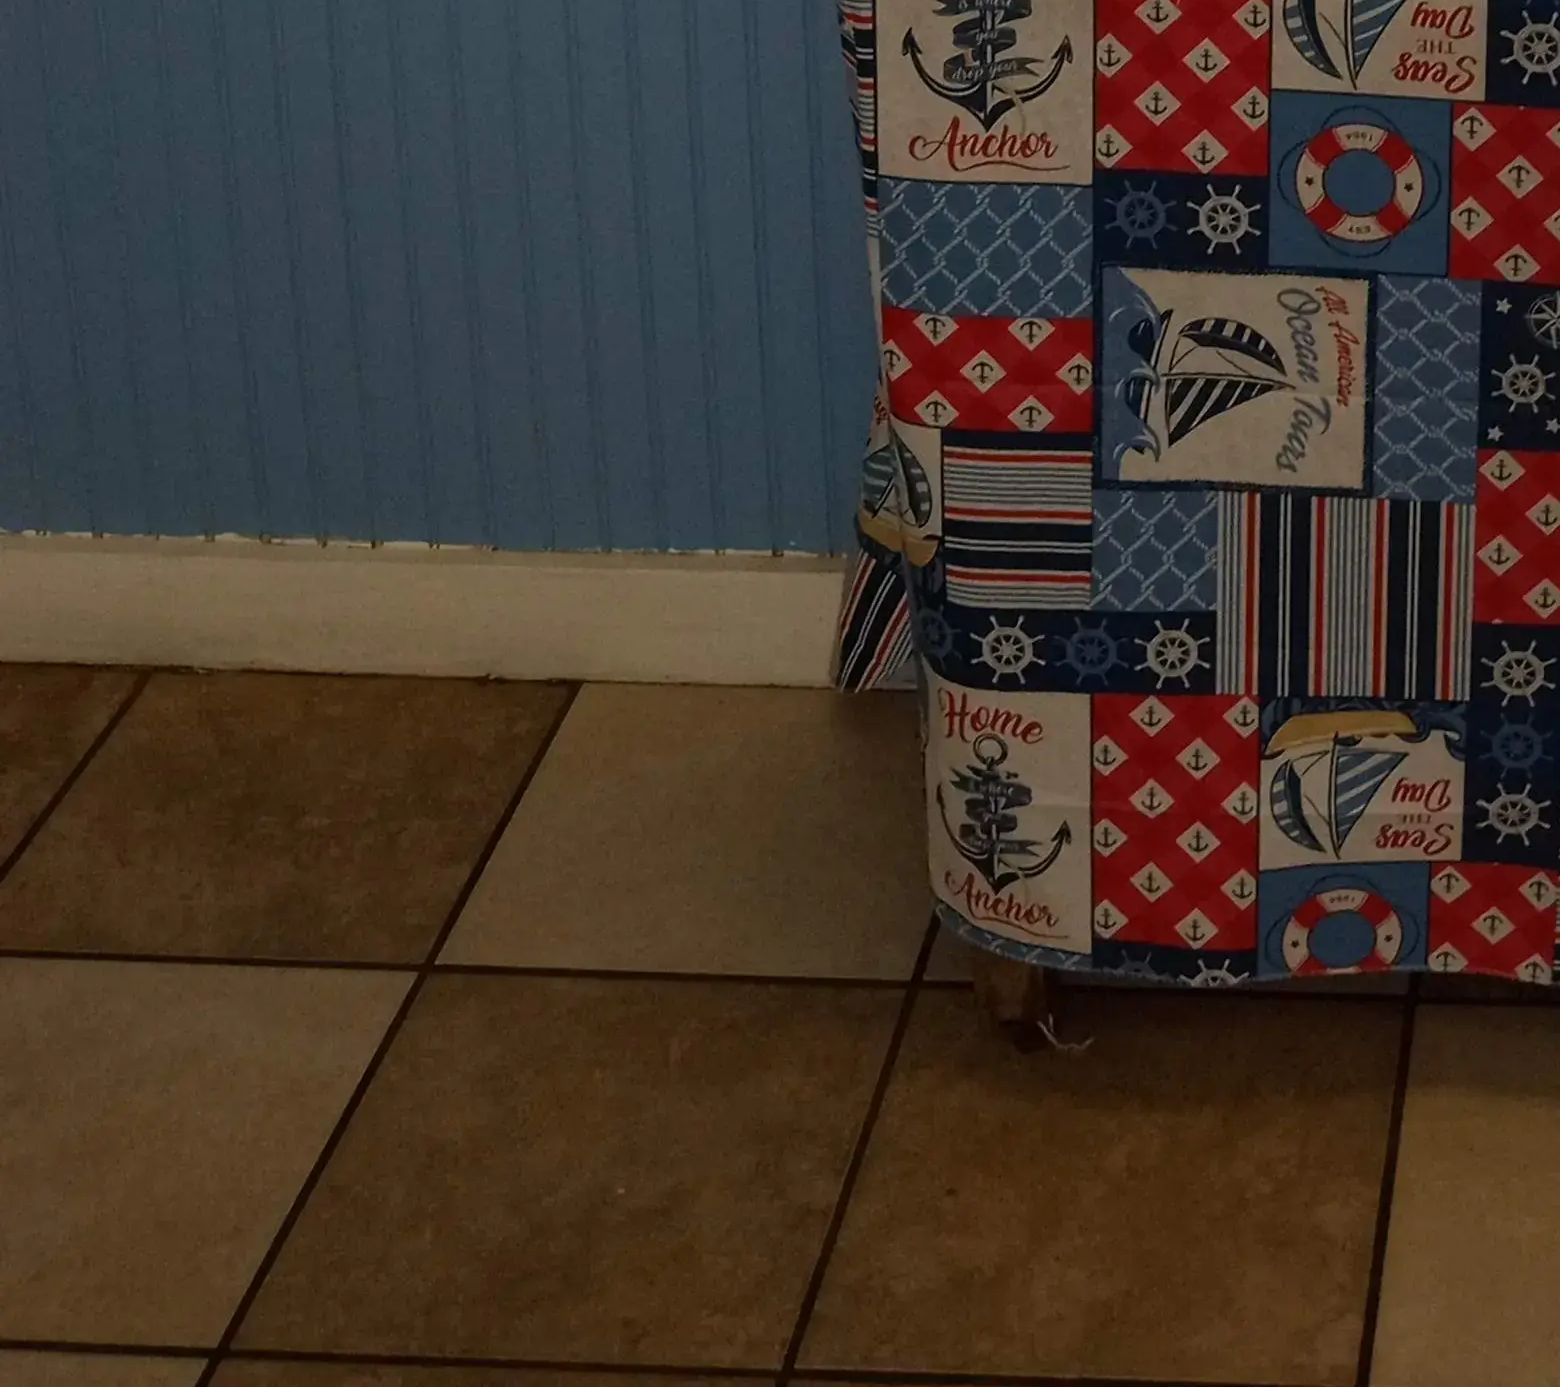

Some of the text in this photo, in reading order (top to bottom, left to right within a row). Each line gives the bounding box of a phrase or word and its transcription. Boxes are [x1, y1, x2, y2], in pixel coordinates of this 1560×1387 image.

[1411, 1, 1475, 39] Day
[1391, 51, 1477, 94] Seas
[909, 115, 1066, 171] Anchor
[1275, 288, 1332, 473] Ocean Tours
[937, 688, 1044, 744] Home
[1392, 777, 1451, 812] Day
[1375, 823, 1454, 856] Seas
[945, 870, 1067, 938] Anchor
